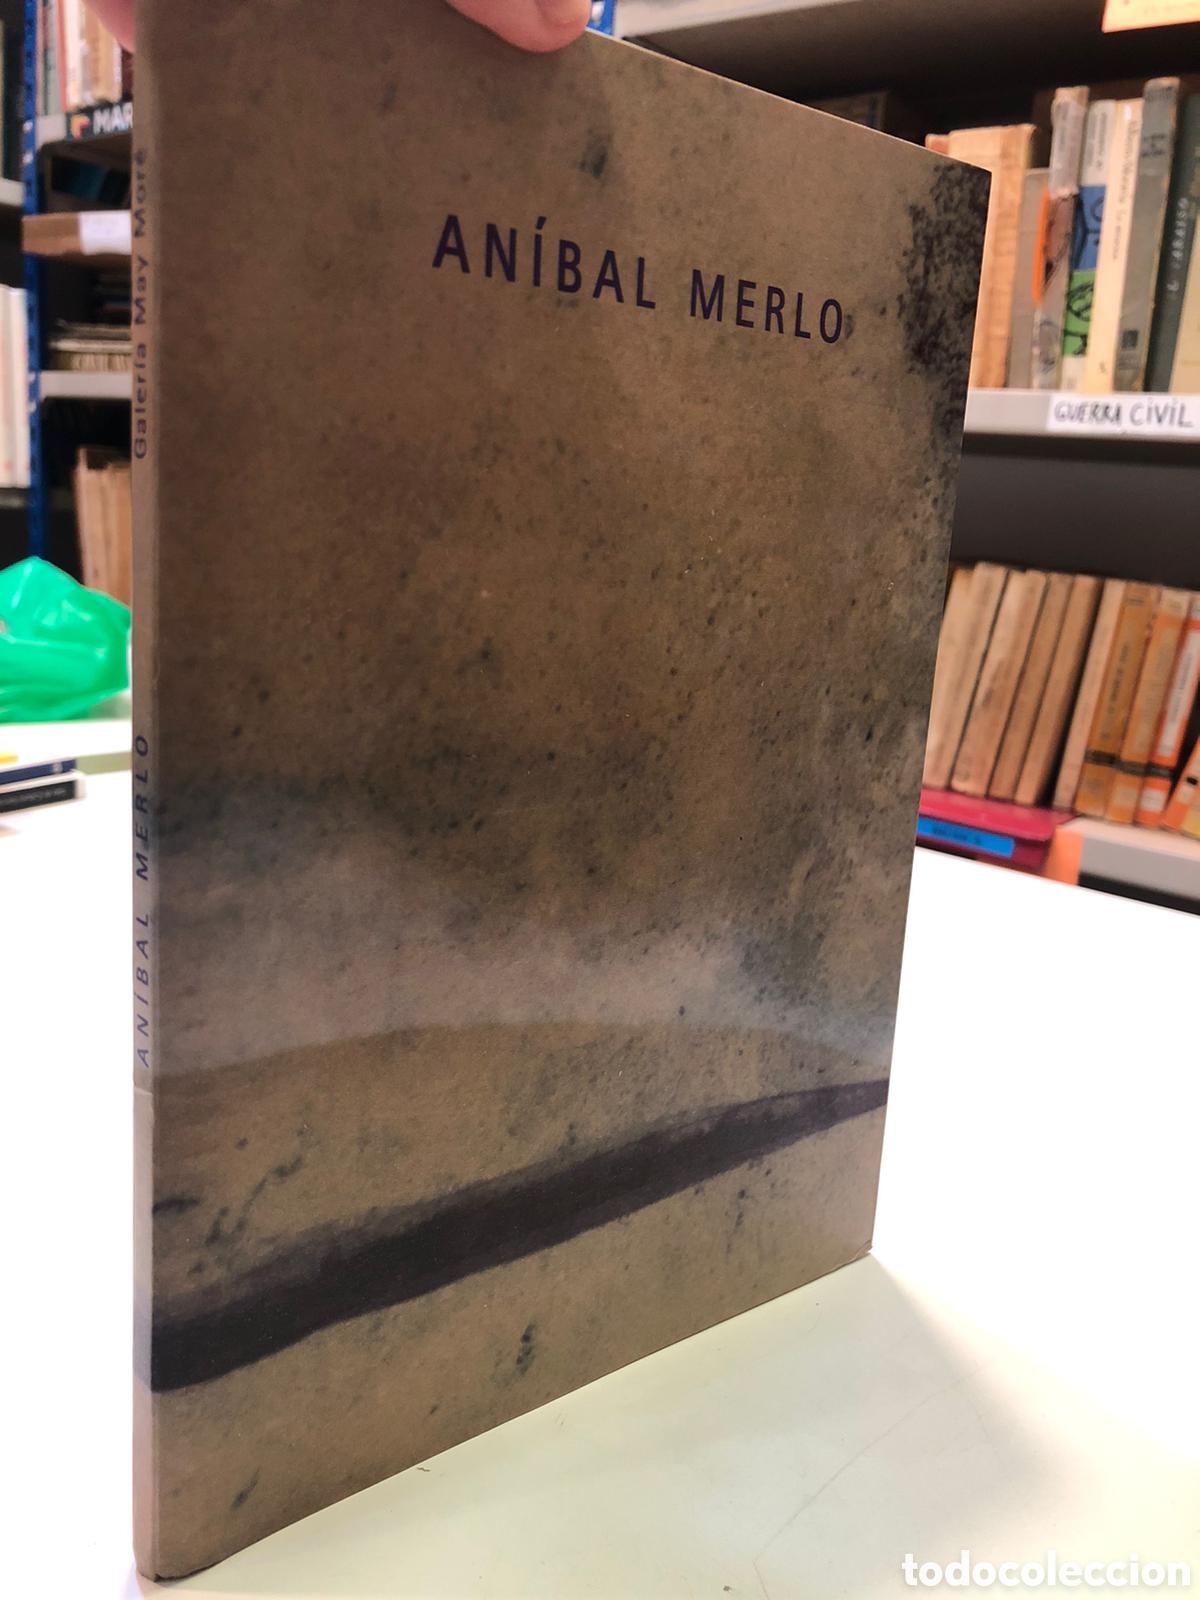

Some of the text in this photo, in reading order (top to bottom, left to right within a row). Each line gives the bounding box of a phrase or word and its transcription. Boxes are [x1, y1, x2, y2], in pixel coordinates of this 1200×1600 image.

[134, 148, 148, 459] Galería May Moré
[432, 214, 842, 344] ANÍBAL MERLO
[1054, 400, 1121, 425] GUERRA
[134, 735, 150, 1068] ANÍBAL MERLO
